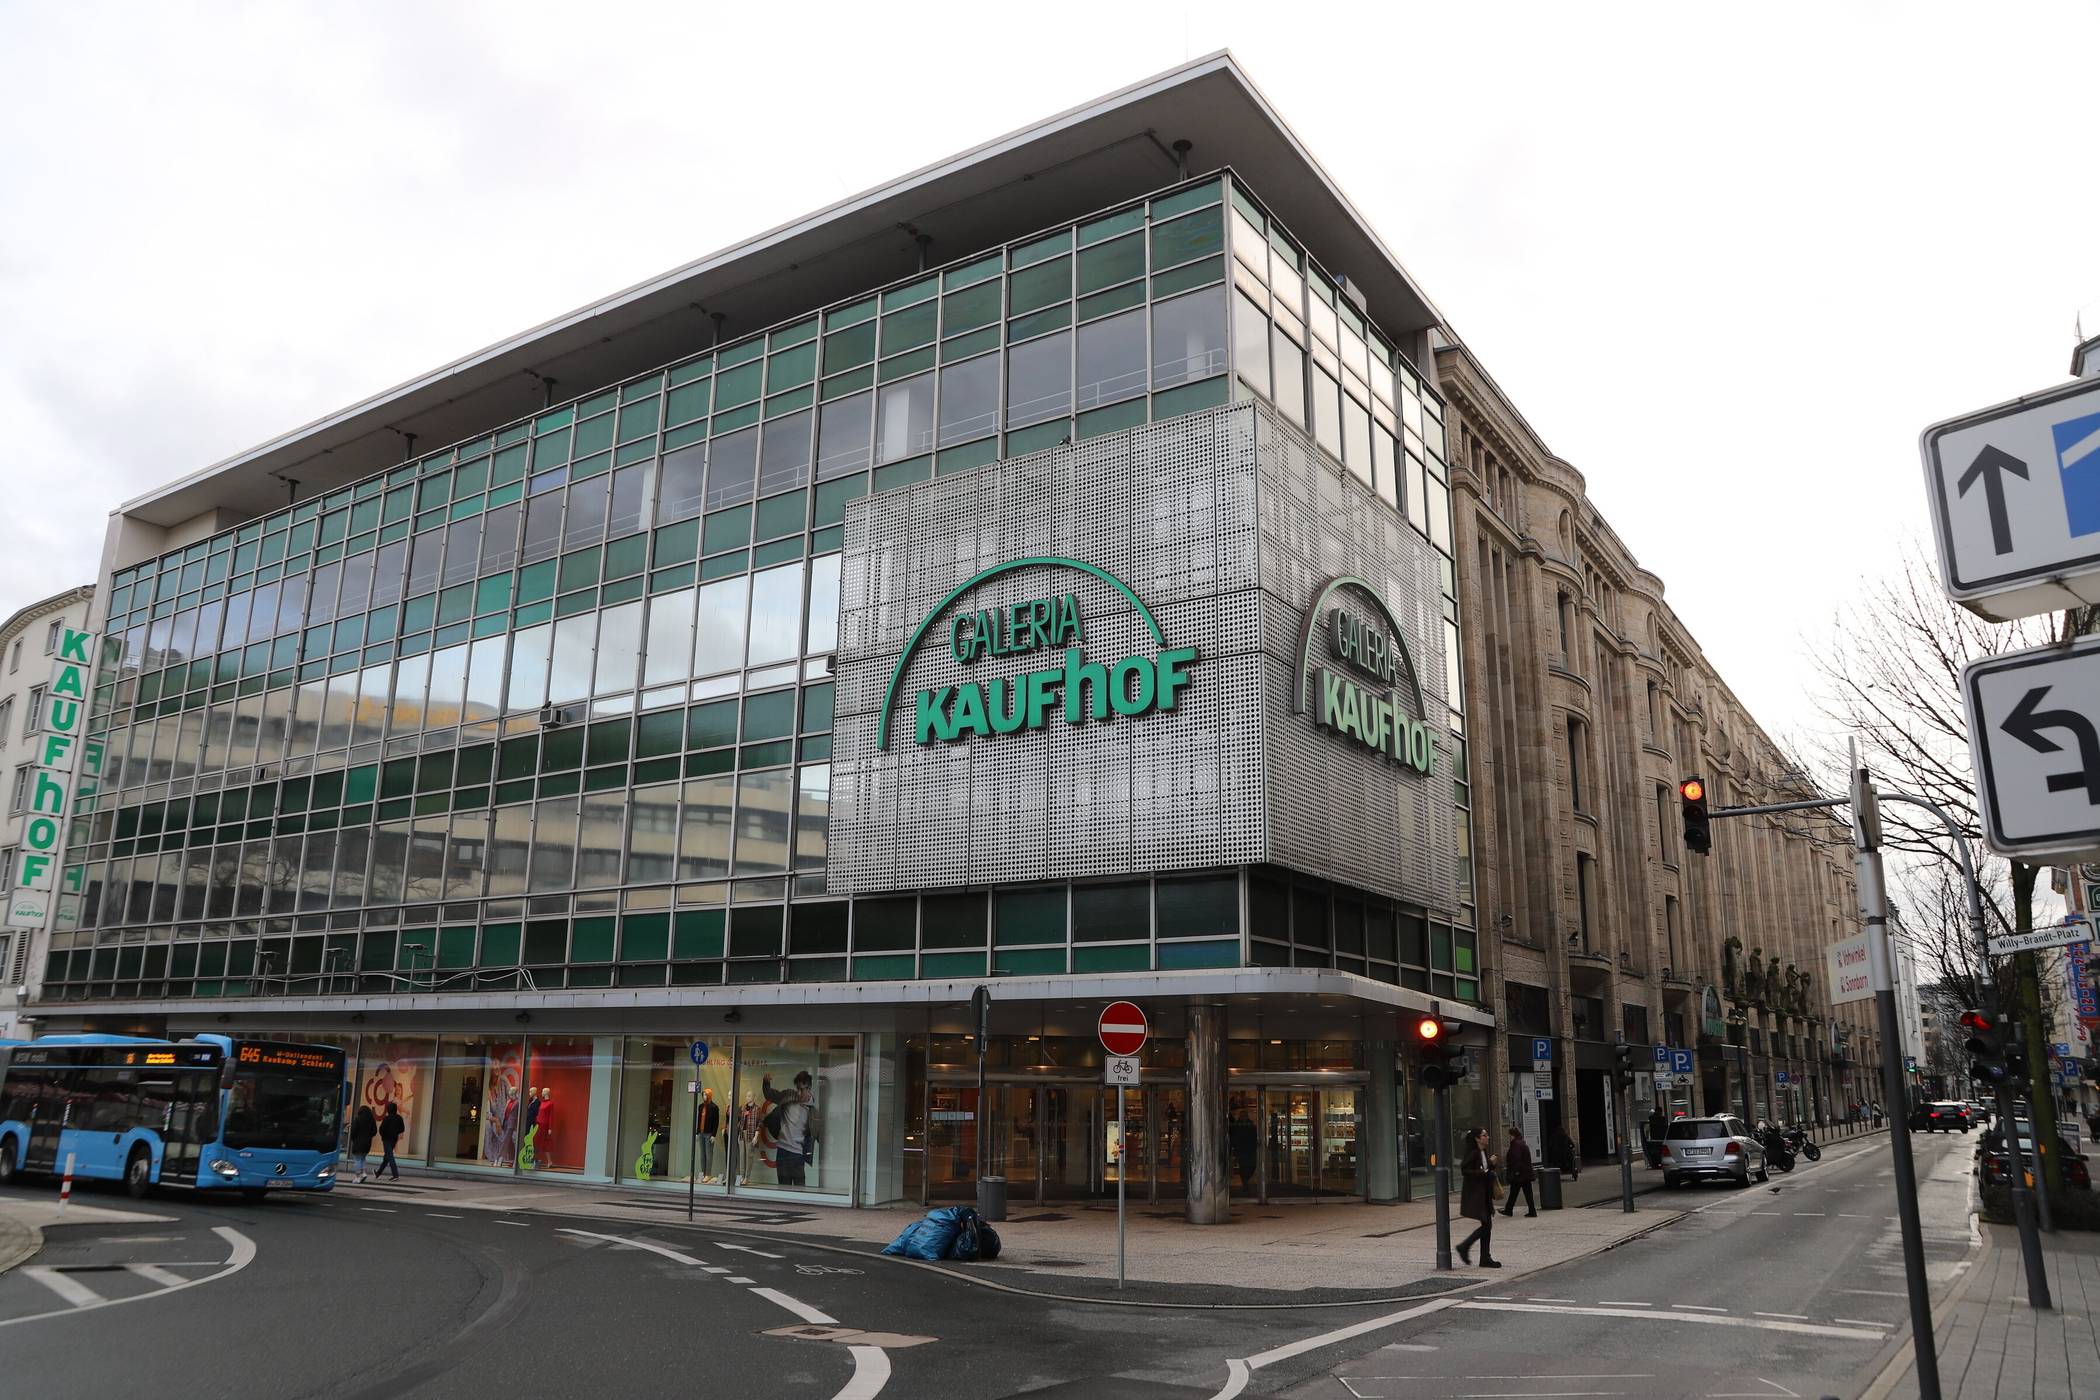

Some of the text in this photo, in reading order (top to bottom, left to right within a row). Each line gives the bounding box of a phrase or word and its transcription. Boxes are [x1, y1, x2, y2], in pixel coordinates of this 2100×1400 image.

[950, 594, 1085, 662] GALERIA
[1329, 607, 1397, 687] GALERIA
[1997, 929, 2080, 949] Willy-Brandt-Platz
[240, 1047, 261, 1062] 645
[302, 1059, 335, 1069] Schleife
